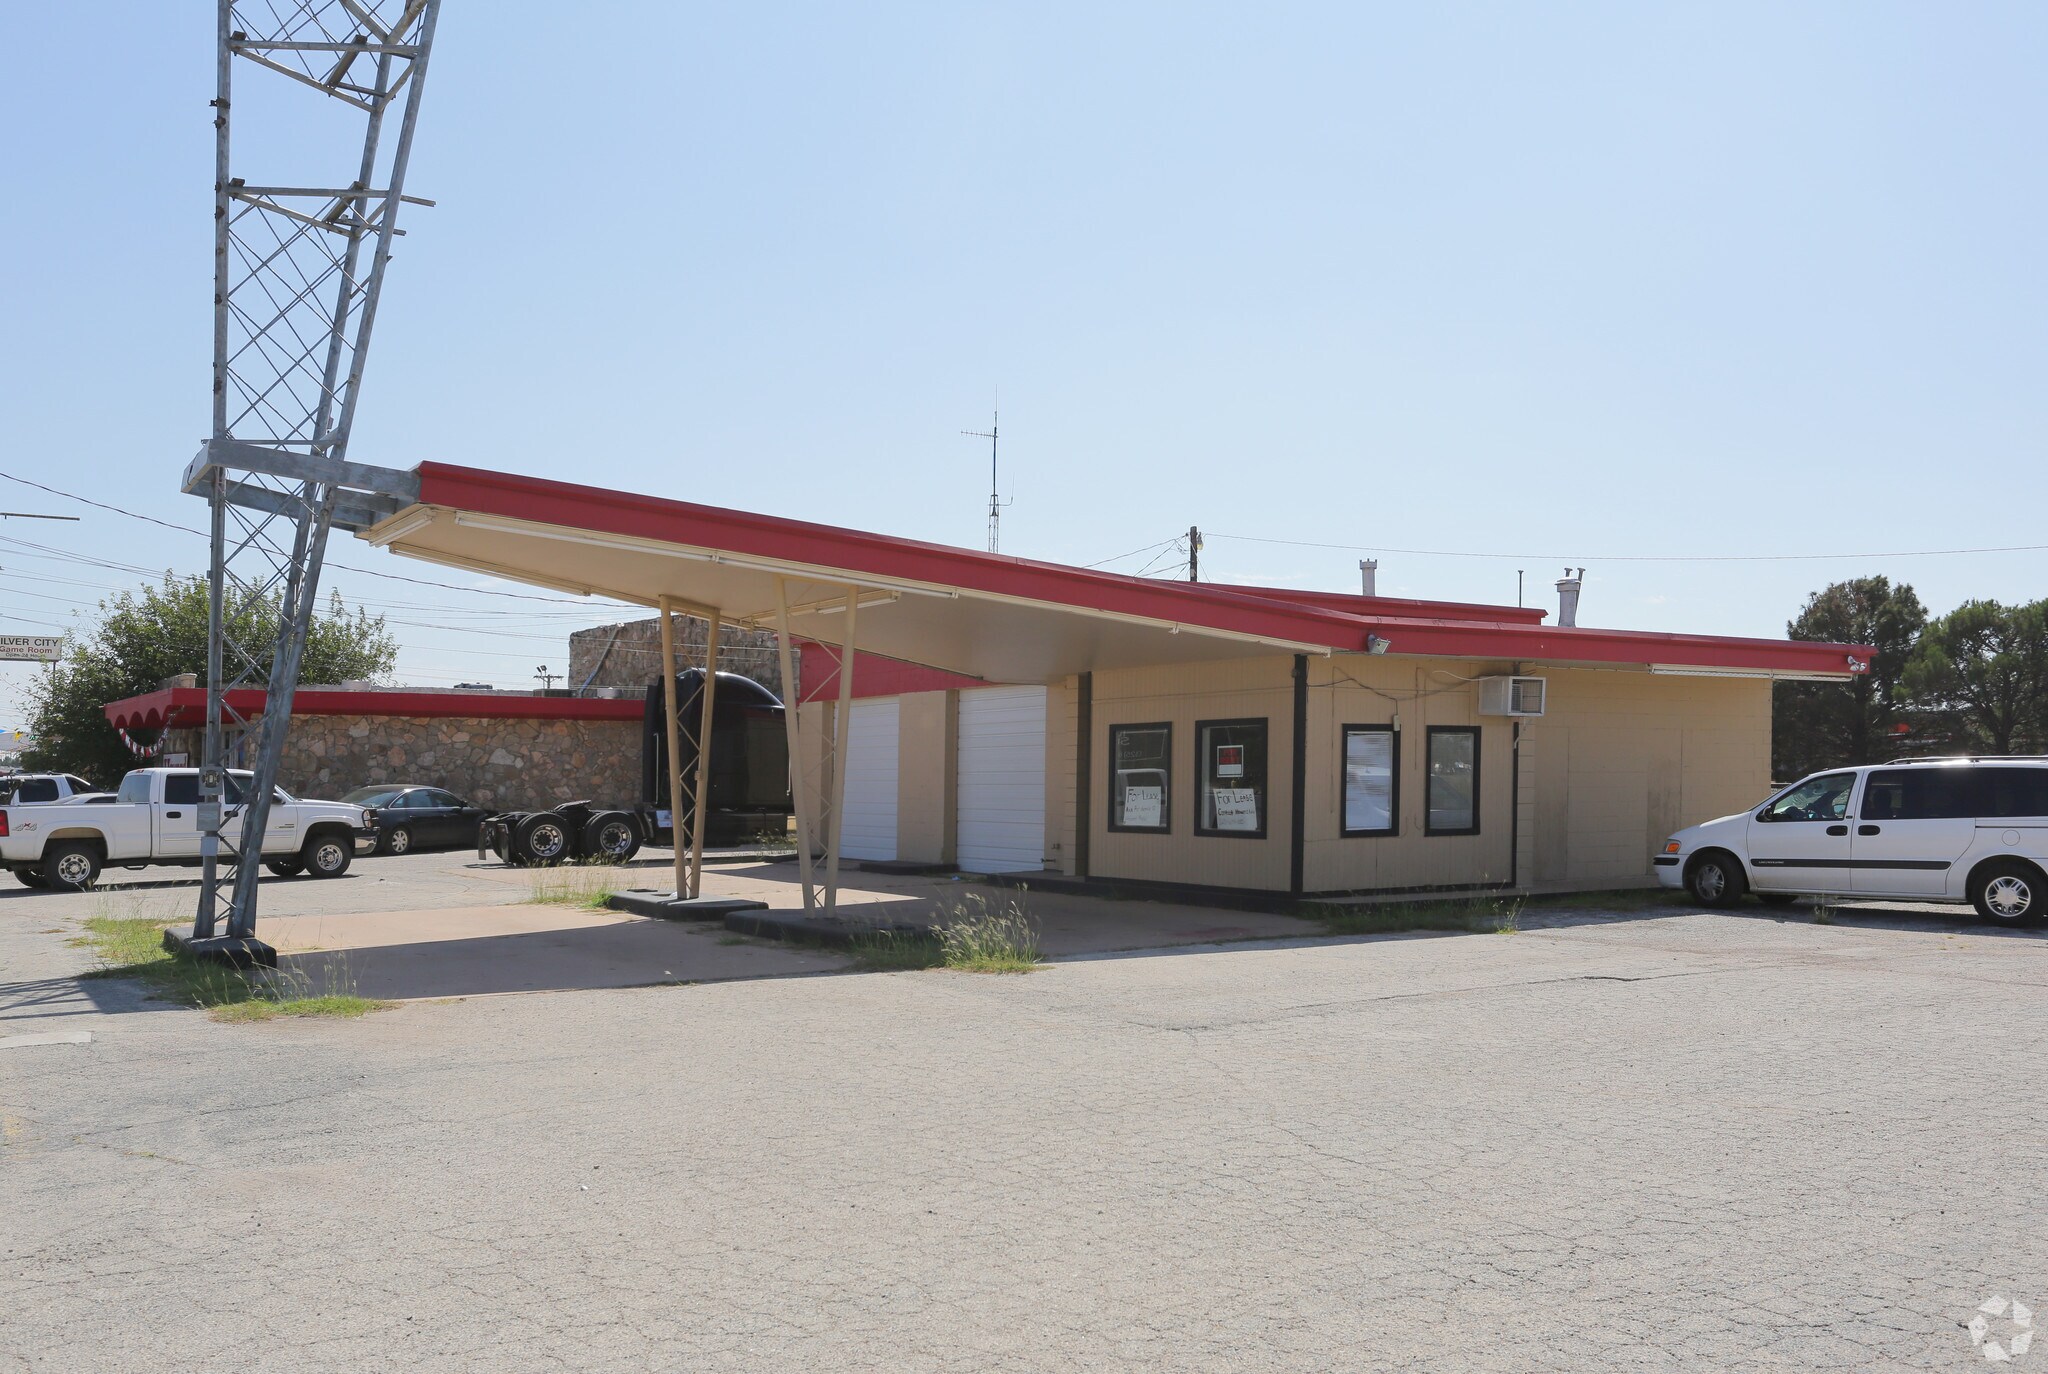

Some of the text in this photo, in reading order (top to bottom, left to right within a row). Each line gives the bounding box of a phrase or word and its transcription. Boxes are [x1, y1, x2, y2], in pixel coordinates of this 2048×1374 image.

[34, 639, 59, 647] CITY
[1216, 790, 1253, 805] For Lease
